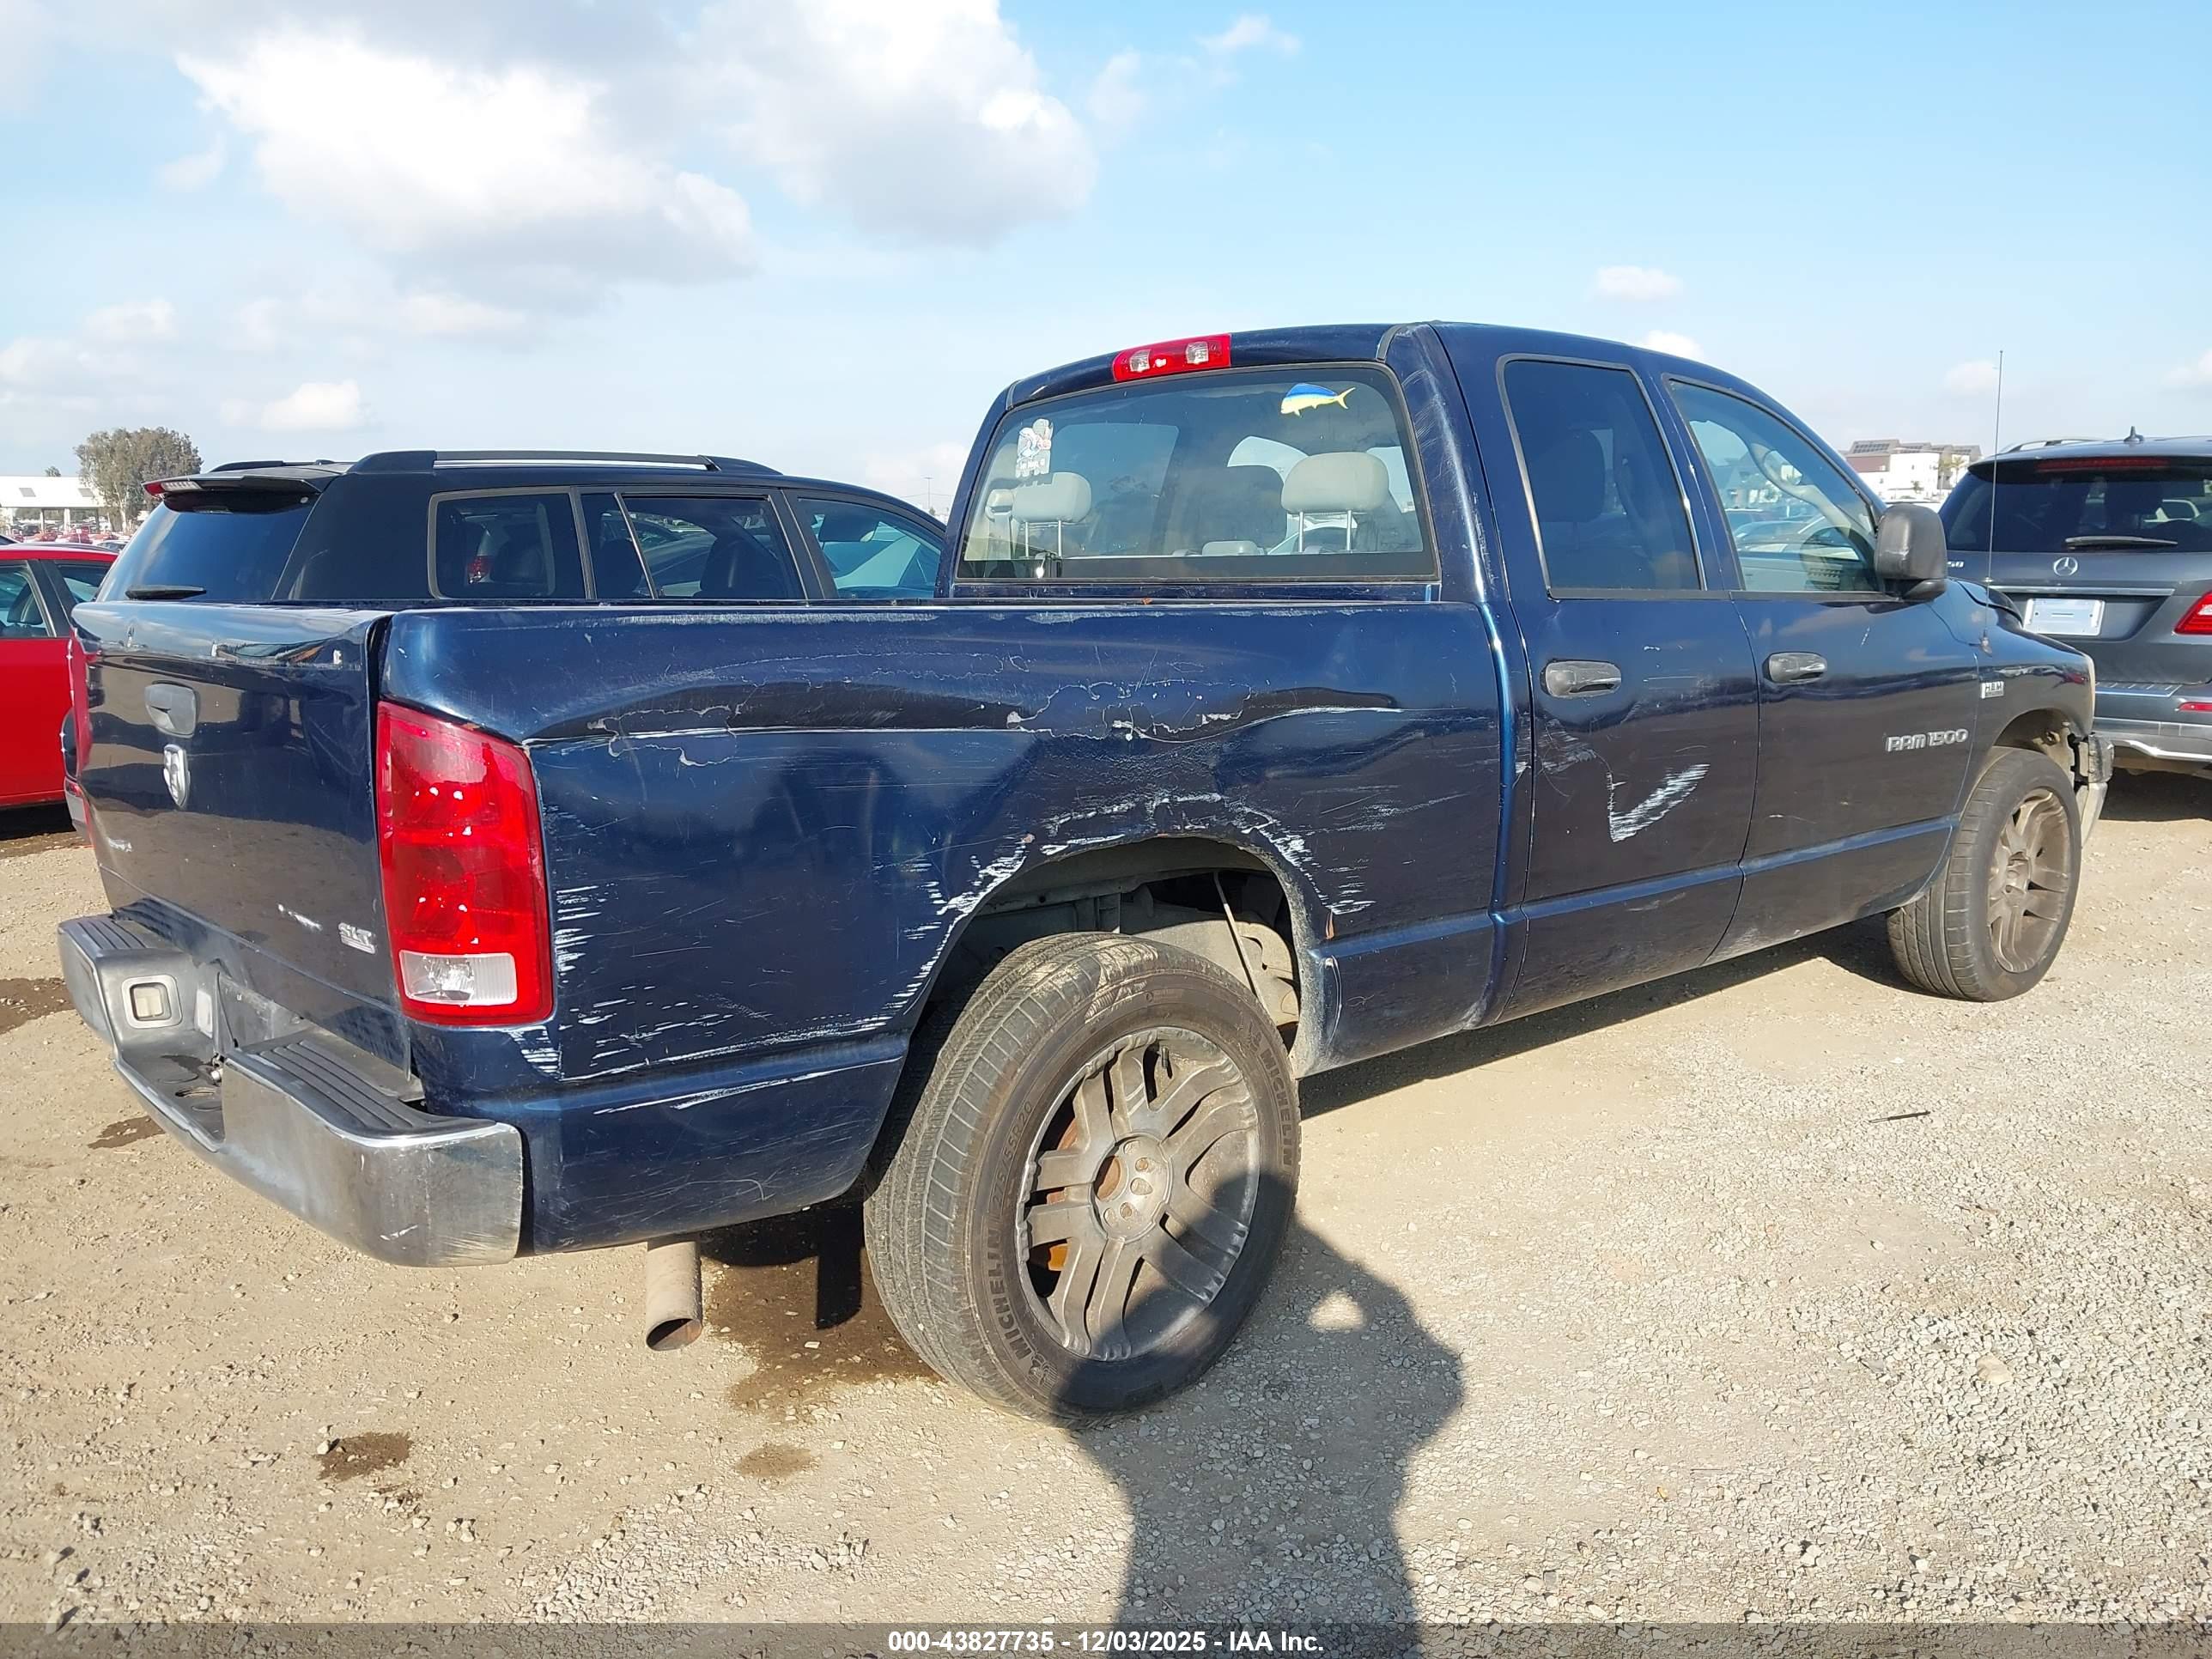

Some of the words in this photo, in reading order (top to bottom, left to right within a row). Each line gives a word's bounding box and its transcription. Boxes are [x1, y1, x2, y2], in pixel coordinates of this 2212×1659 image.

[1885, 733, 1926, 752] RAM
[1927, 728, 1968, 746] 1500
[337, 922, 373, 949] SLT
[1260, 1048, 1292, 1166] MICHELIN
[988, 1227, 1032, 1360] MICHELIN
